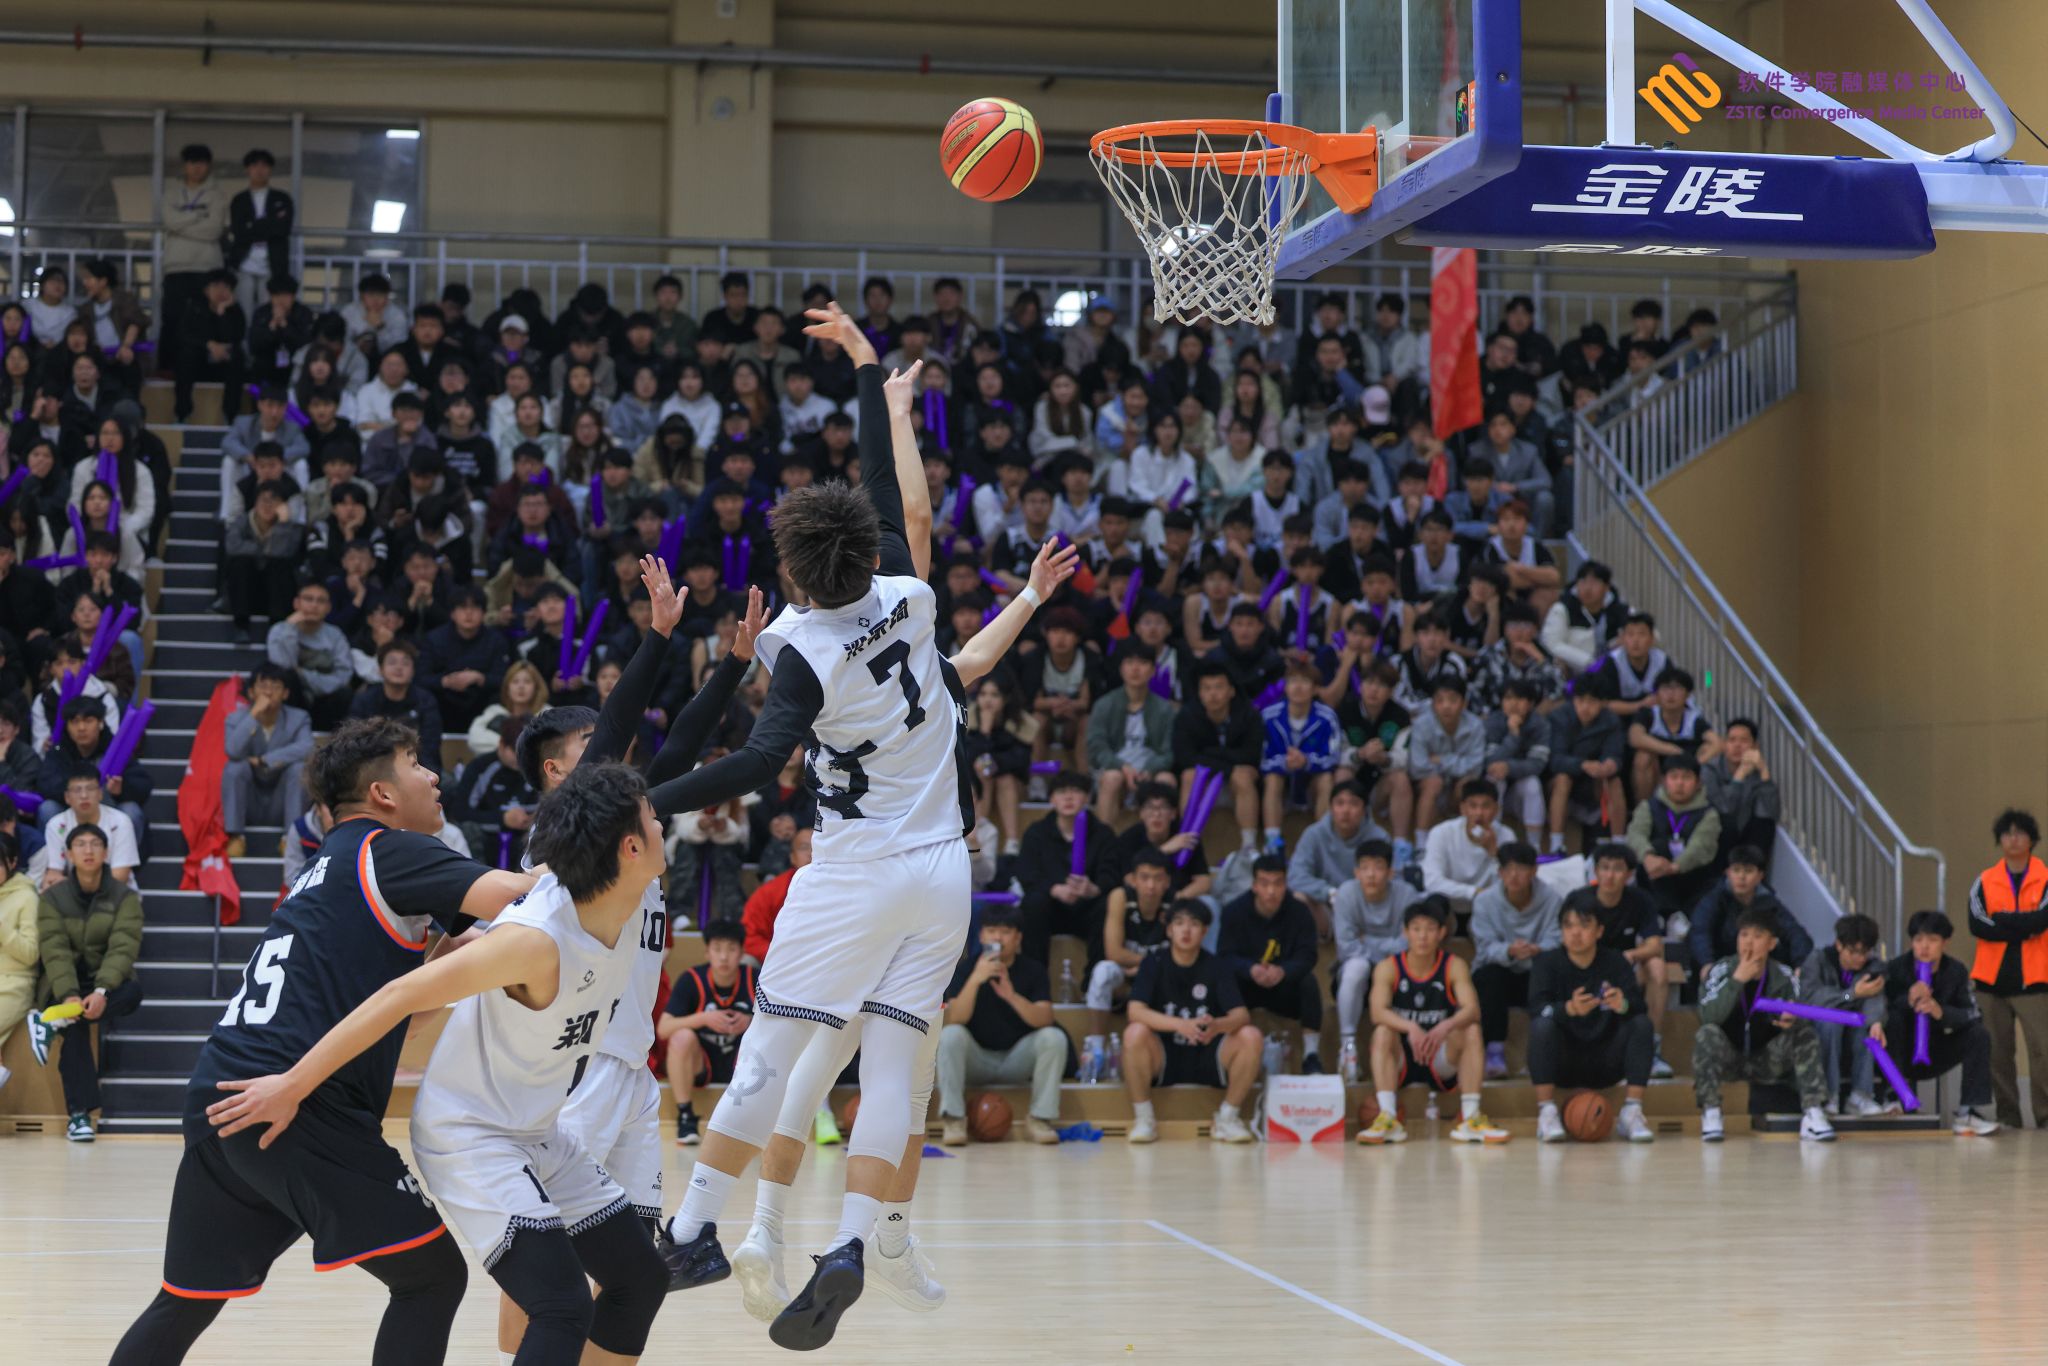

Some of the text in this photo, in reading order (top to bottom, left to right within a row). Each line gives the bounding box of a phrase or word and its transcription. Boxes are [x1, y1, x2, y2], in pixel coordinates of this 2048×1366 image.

[1530, 164, 1804, 221] 金陵
[866, 638, 926, 732] 7
[639, 908, 666, 953] 10
[217, 933, 295, 1027] 15
